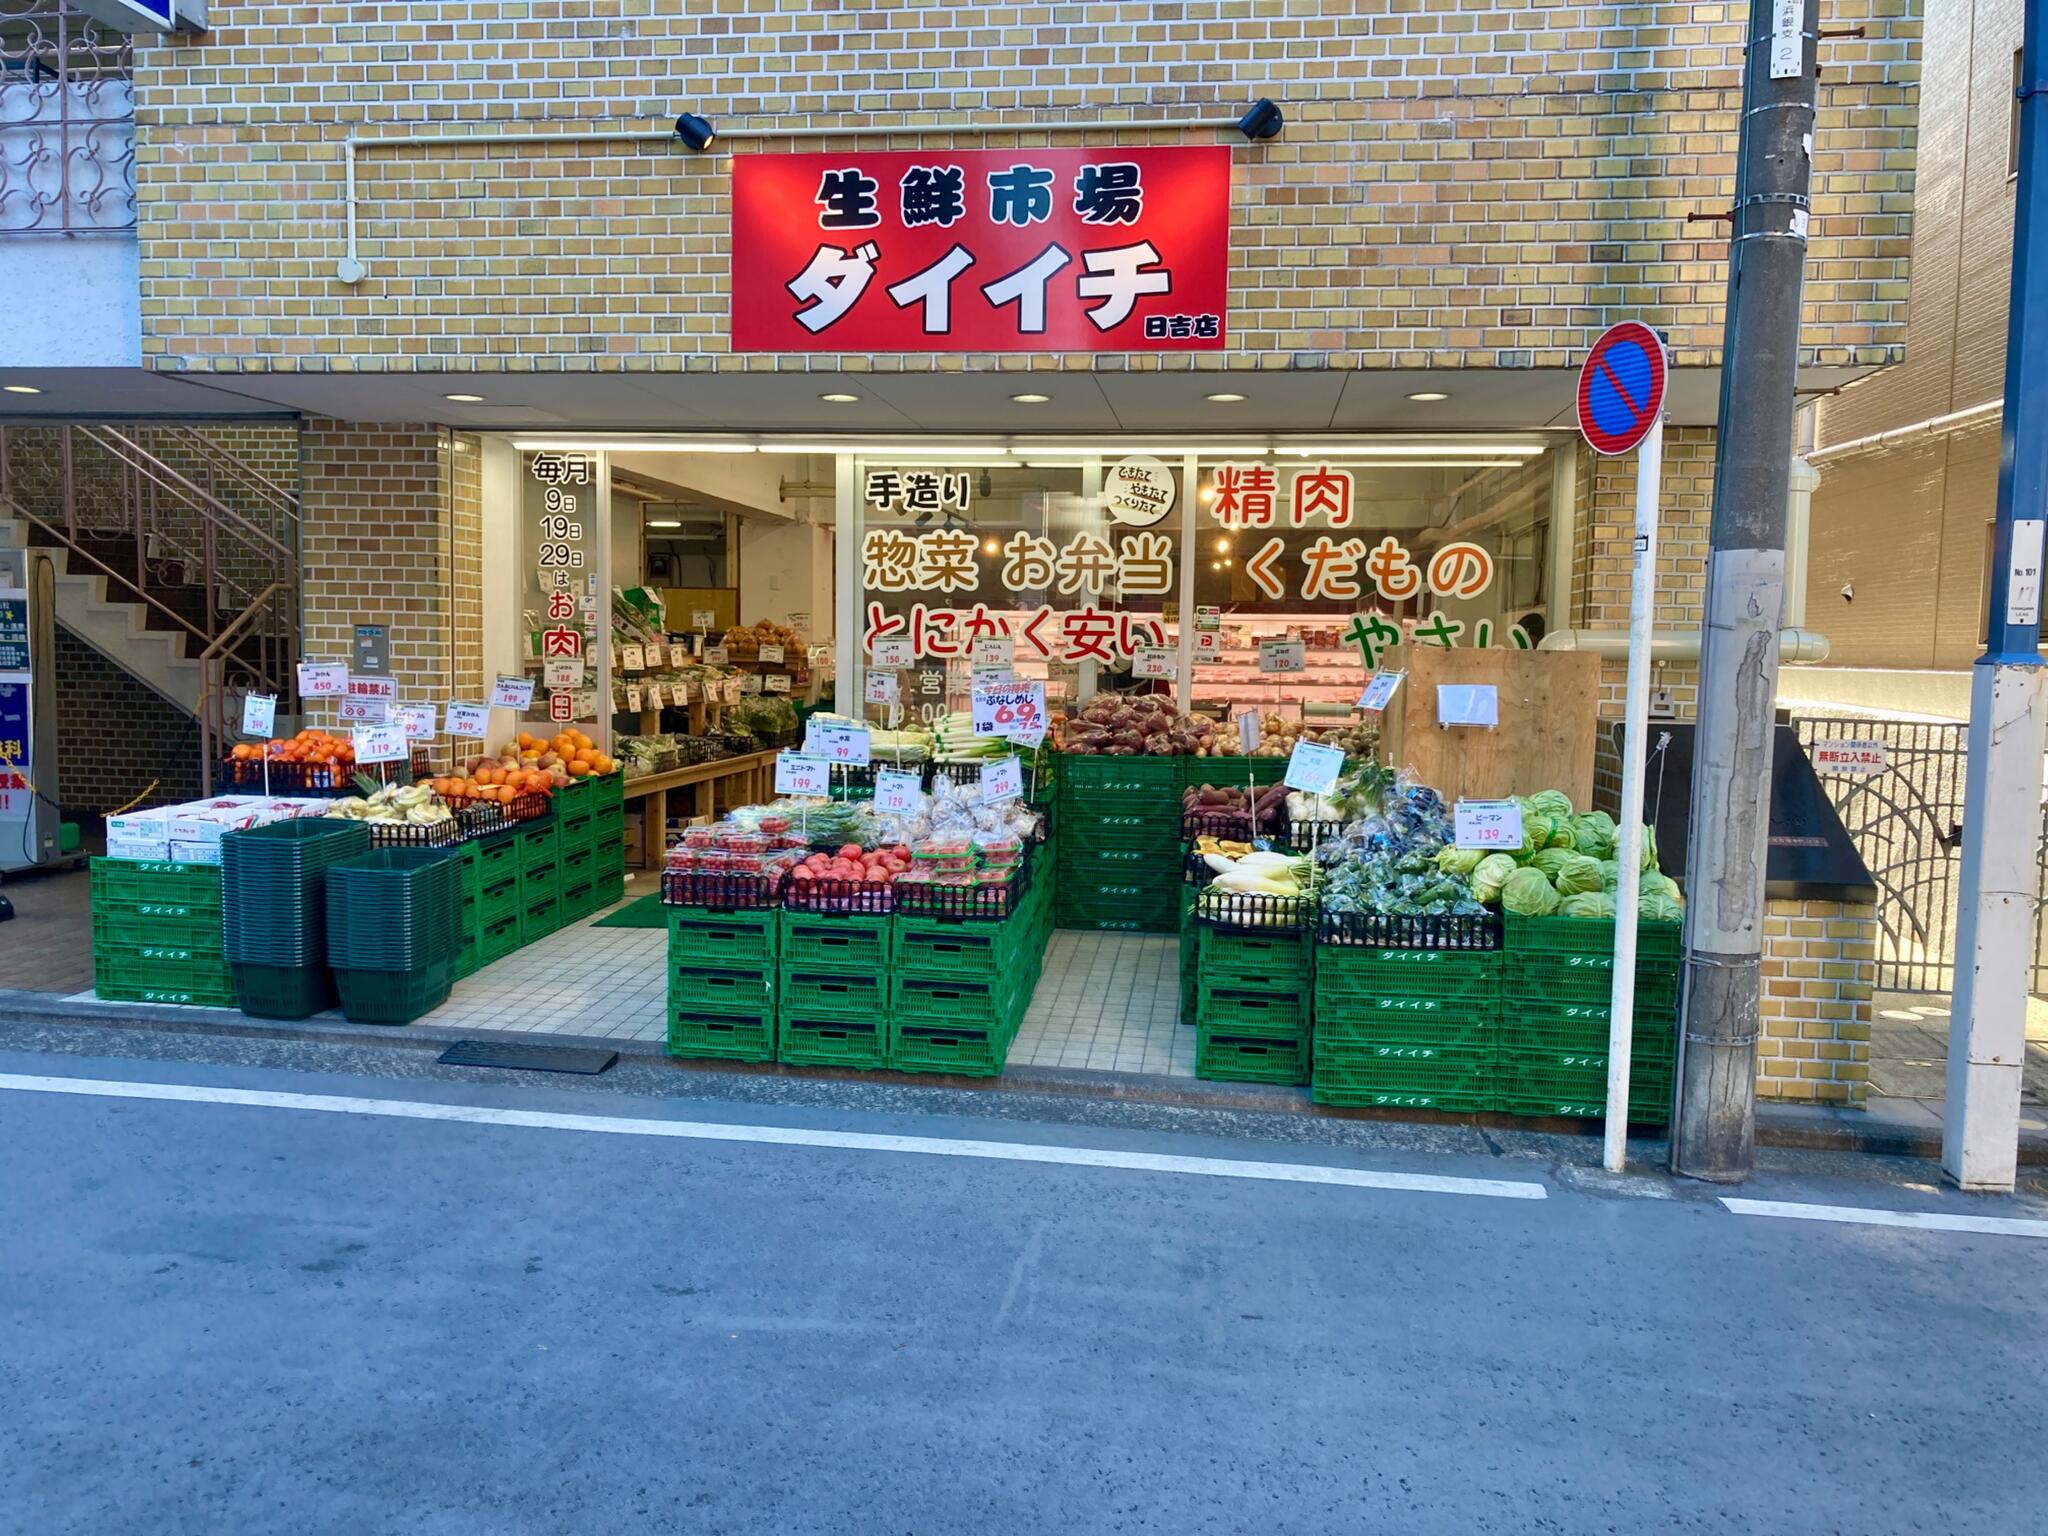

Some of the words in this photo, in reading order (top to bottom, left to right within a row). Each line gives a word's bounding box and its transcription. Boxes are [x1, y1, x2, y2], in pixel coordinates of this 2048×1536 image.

[1780, 47, 1792, 60] 2
[815, 163, 1144, 230] 生鮮市場
[785, 239, 1171, 335] ダイイチ
[1143, 315, 1219, 339] 日吉店
[532, 453, 589, 485] 毎月
[1118, 466, 1152, 482] できたて
[865, 471, 972, 512] 手造り
[1210, 460, 1354, 529] 精肉
[545, 488, 576, 512] 9日
[1113, 495, 1157, 515] つくりたて
[539, 516, 582, 541] 19日
[539, 543, 584, 568] 29日
[862, 529, 979, 593] 惣菜
[1001, 531, 1174, 594] お弁当
[1246, 536, 1494, 600] くだもの
[885, 655, 900, 664] 150
[1274, 659, 1290, 668] 120
[314, 682, 331, 690] 450
[986, 694, 1034, 706] ぶなしめじ
[457, 722, 473, 731] 399
[371, 744, 389, 754] 119
[836, 747, 849, 757] 99
[1818, 751, 1882, 764] 無断立入禁止
[793, 778, 811, 788] 199
[888, 796, 903, 807] 129
[1477, 829, 1499, 840] 139
[1382, 951, 1438, 961] ダイイチ
[1569, 957, 1611, 967] ダイイ
[1380, 1000, 1436, 1010] ダイイチ
[1566, 1008, 1607, 1018] ダイイ
[1378, 1048, 1434, 1058] ダイイチ
[1563, 1057, 1604, 1067] ダイイ
[1376, 1095, 1432, 1105] ダイイチ
[1560, 1105, 1601, 1116] ダイイ
